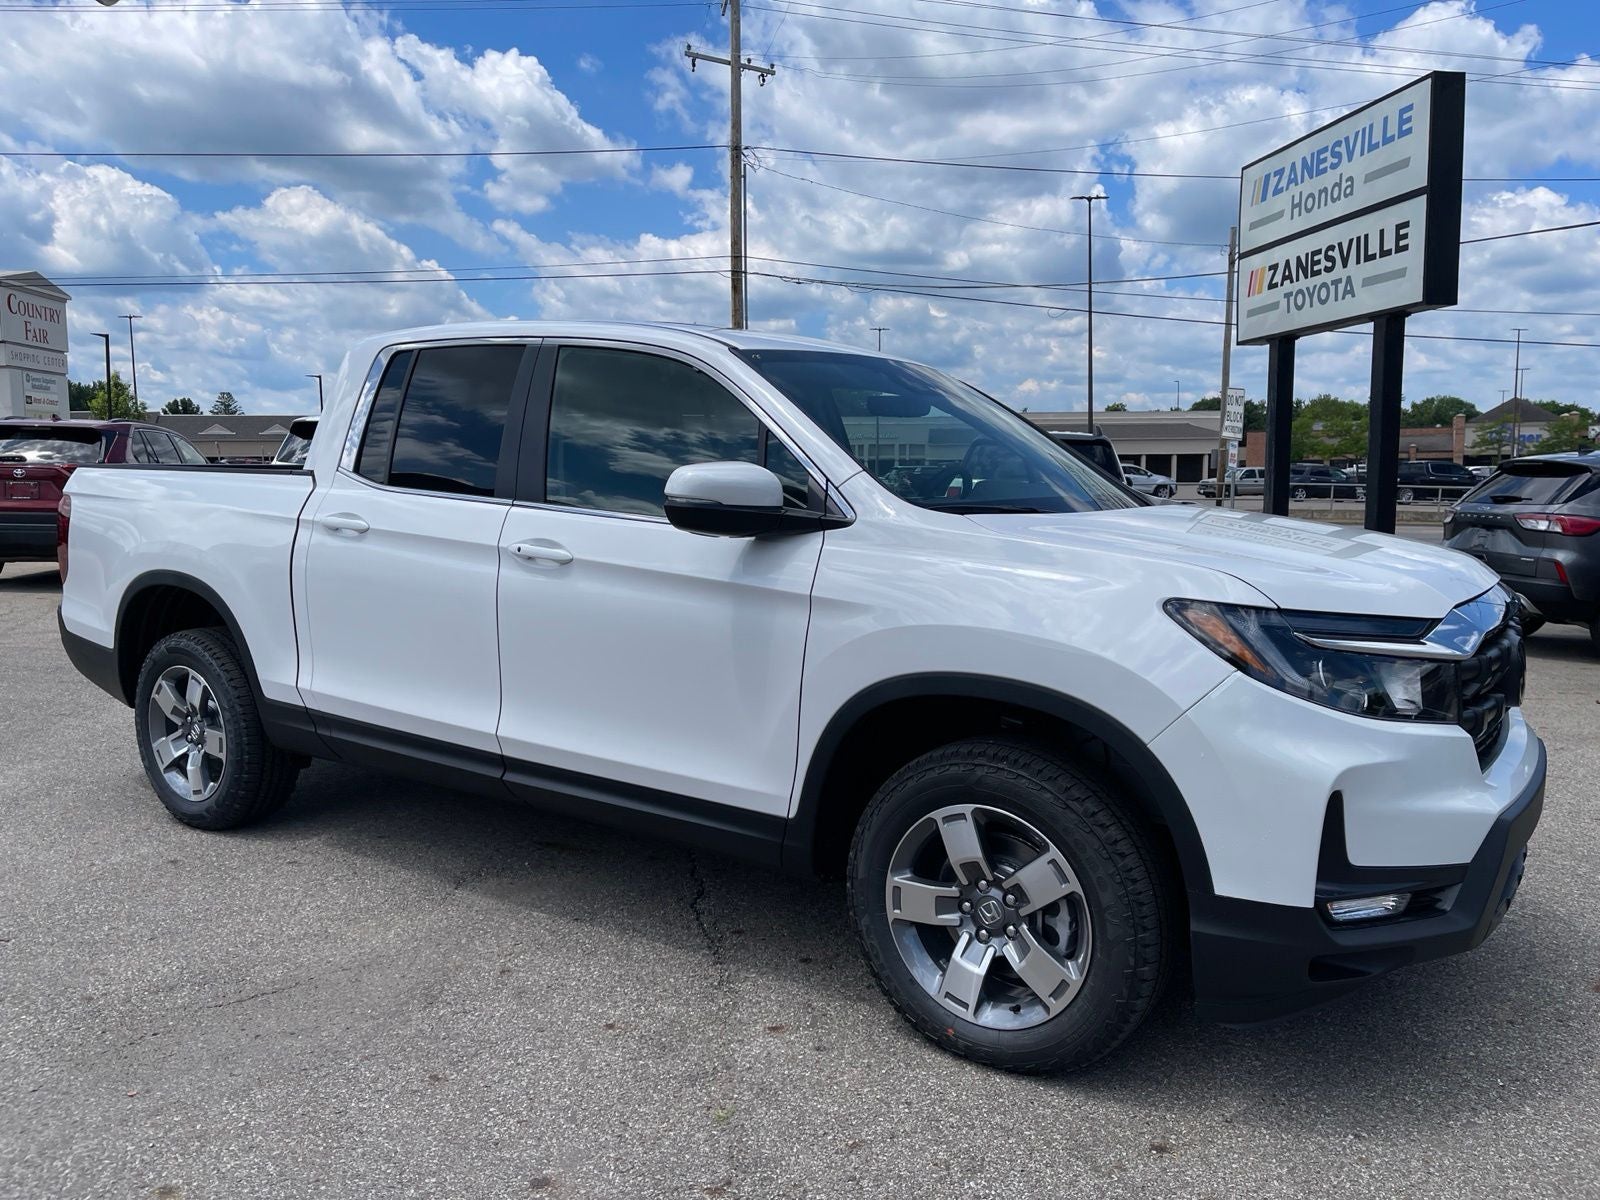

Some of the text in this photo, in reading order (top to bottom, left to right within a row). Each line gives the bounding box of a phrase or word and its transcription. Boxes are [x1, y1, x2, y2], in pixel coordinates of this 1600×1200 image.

[1271, 103, 1415, 198] ZANESVILLE
[1290, 172, 1355, 221] Honda
[1267, 220, 1410, 291] ZANESVILLE
[7, 293, 61, 324] COUNTRY
[1283, 275, 1356, 314] TOYOTA
[24, 320, 49, 344] FAIR
[10, 351, 65, 368] SHOPPING CENTER
[1226, 411, 1243, 422] BLOCK
[1227, 395, 1244, 407] DO NOT
